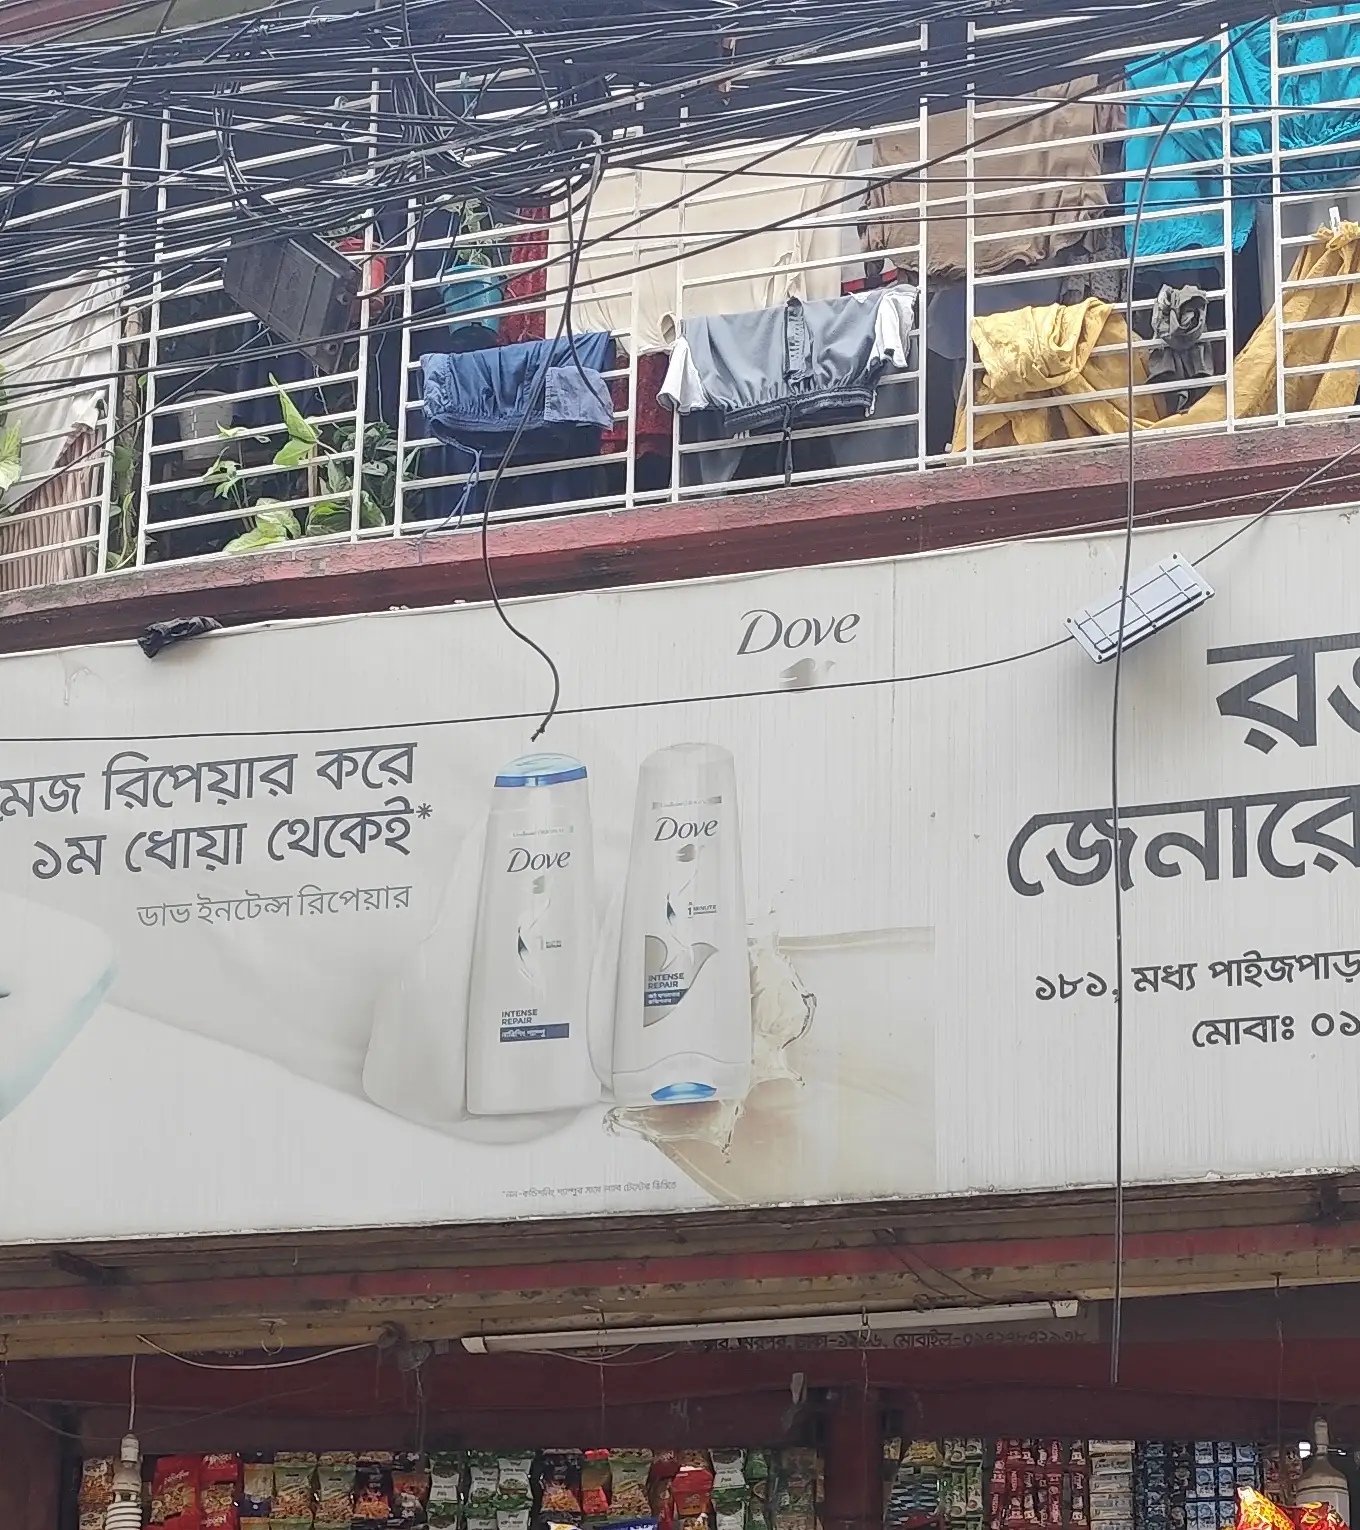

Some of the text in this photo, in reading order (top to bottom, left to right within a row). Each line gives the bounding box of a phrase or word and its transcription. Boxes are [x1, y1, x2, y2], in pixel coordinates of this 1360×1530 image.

[736, 608, 859, 656] Dove
[101, 751, 298, 811] রিপেয়ার
[316, 741, 418, 790] করে
[655, 816, 718, 841] Dove
[31, 833, 106, 880] ১ম
[125, 823, 247, 874] ধোয়া
[507, 848, 570, 872] Dove
[137, 899, 191, 929] ডাভ
[298, 882, 411, 918] রিপেয়ার
[648, 972, 684, 982] INTENSE
[648, 980, 679, 990] REPAIR
[1132, 960, 1196, 996] মধ্য
[501, 1008, 538, 1018] INTENSE
[501, 1016, 532, 1026] REPAIR
